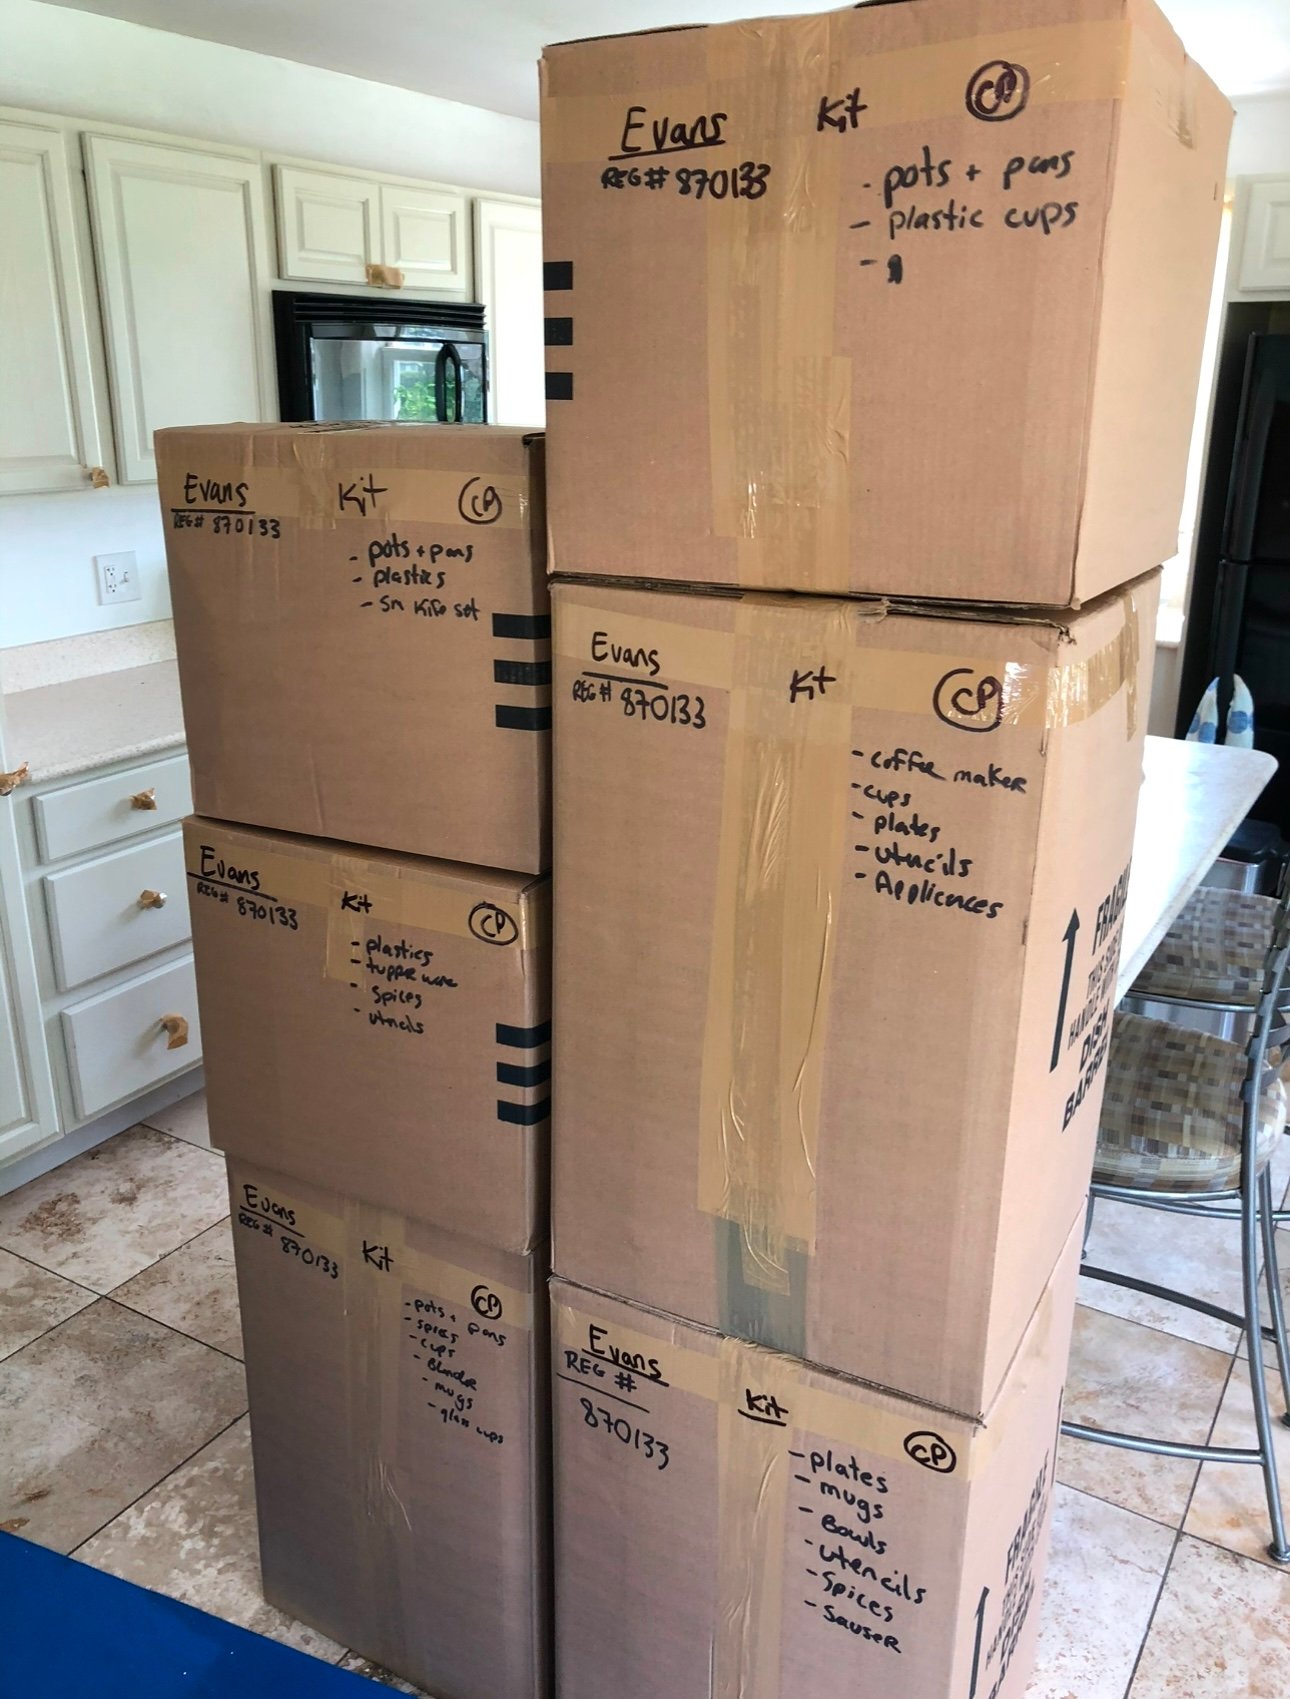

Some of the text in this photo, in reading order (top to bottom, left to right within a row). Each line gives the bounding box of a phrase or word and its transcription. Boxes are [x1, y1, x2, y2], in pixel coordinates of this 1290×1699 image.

[621, 106, 727, 151] Evans
[817, 88, 867, 132] Kit
[676, 161, 771, 199] 870133
[884, 145, 951, 208] pots
[890, 199, 984, 240] plastic
[1004, 201, 1079, 235] cups
[184, 472, 249, 507] Evans
[339, 473, 388, 516] Kit
[213, 516, 280, 538] 870133
[369, 533, 410, 567] pots
[591, 631, 660, 676] Evans
[789, 666, 836, 703] Kit
[620, 688, 706, 729] 870133
[874, 811, 941, 843] plates
[200, 845, 260, 890] Evans
[237, 896, 298, 930] 870133
[341, 891, 373, 914] Kit
[243, 1184, 296, 1226] Evans
[280, 1236, 338, 1279] 870133
[363, 1241, 394, 1272] Kit
[565, 1350, 605, 1377] REG
[589, 1324, 662, 1379] Evans
[435, 1382, 473, 1412] mugs
[746, 1389, 788, 1418] Kit
[580, 1398, 669, 1469] 870133
[811, 1450, 888, 1493] plates
[820, 1481, 883, 1523] mugs
[822, 1514, 887, 1554] Bowls
